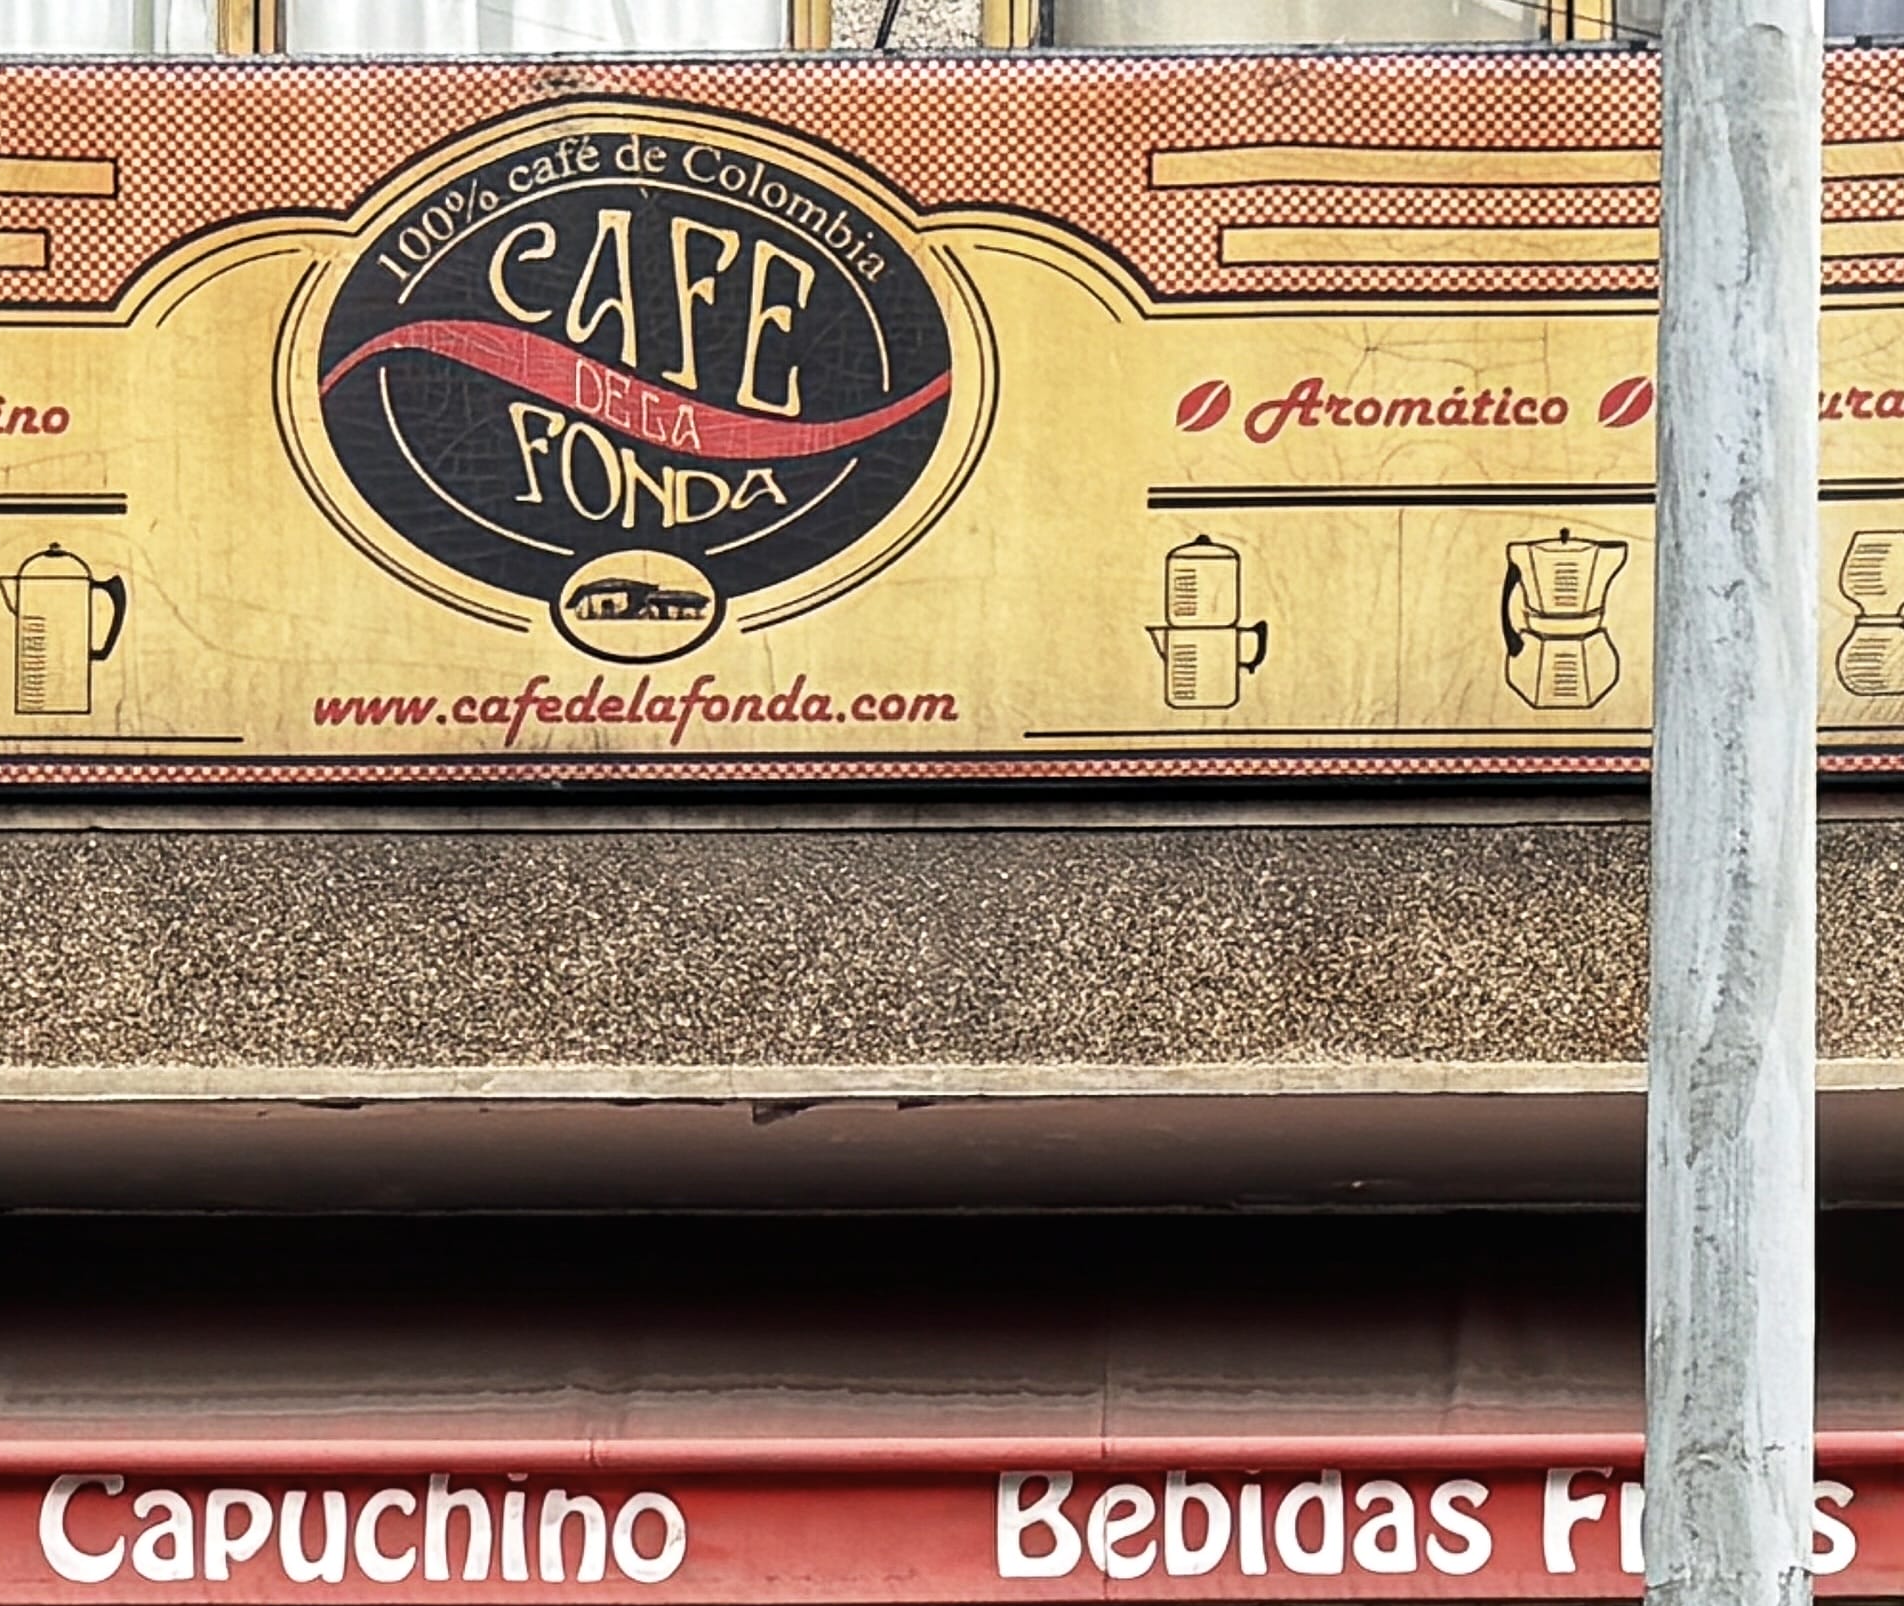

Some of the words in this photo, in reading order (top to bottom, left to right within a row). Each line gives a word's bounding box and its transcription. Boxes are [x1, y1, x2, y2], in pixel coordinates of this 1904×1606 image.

[375, 178, 501, 284] 100%
[507, 136, 602, 194] café
[616, 134, 668, 175] de
[681, 147, 889, 284] Colombia
[573, 358, 631, 429] DE
[1243, 376, 1571, 444] Aromático
[507, 402, 788, 530] FONDA
[312, 674, 960, 747] www.cafedelafonda.com
[38, 1472, 688, 1584] Capuchino
[995, 1467, 1495, 1580] Bebidas
